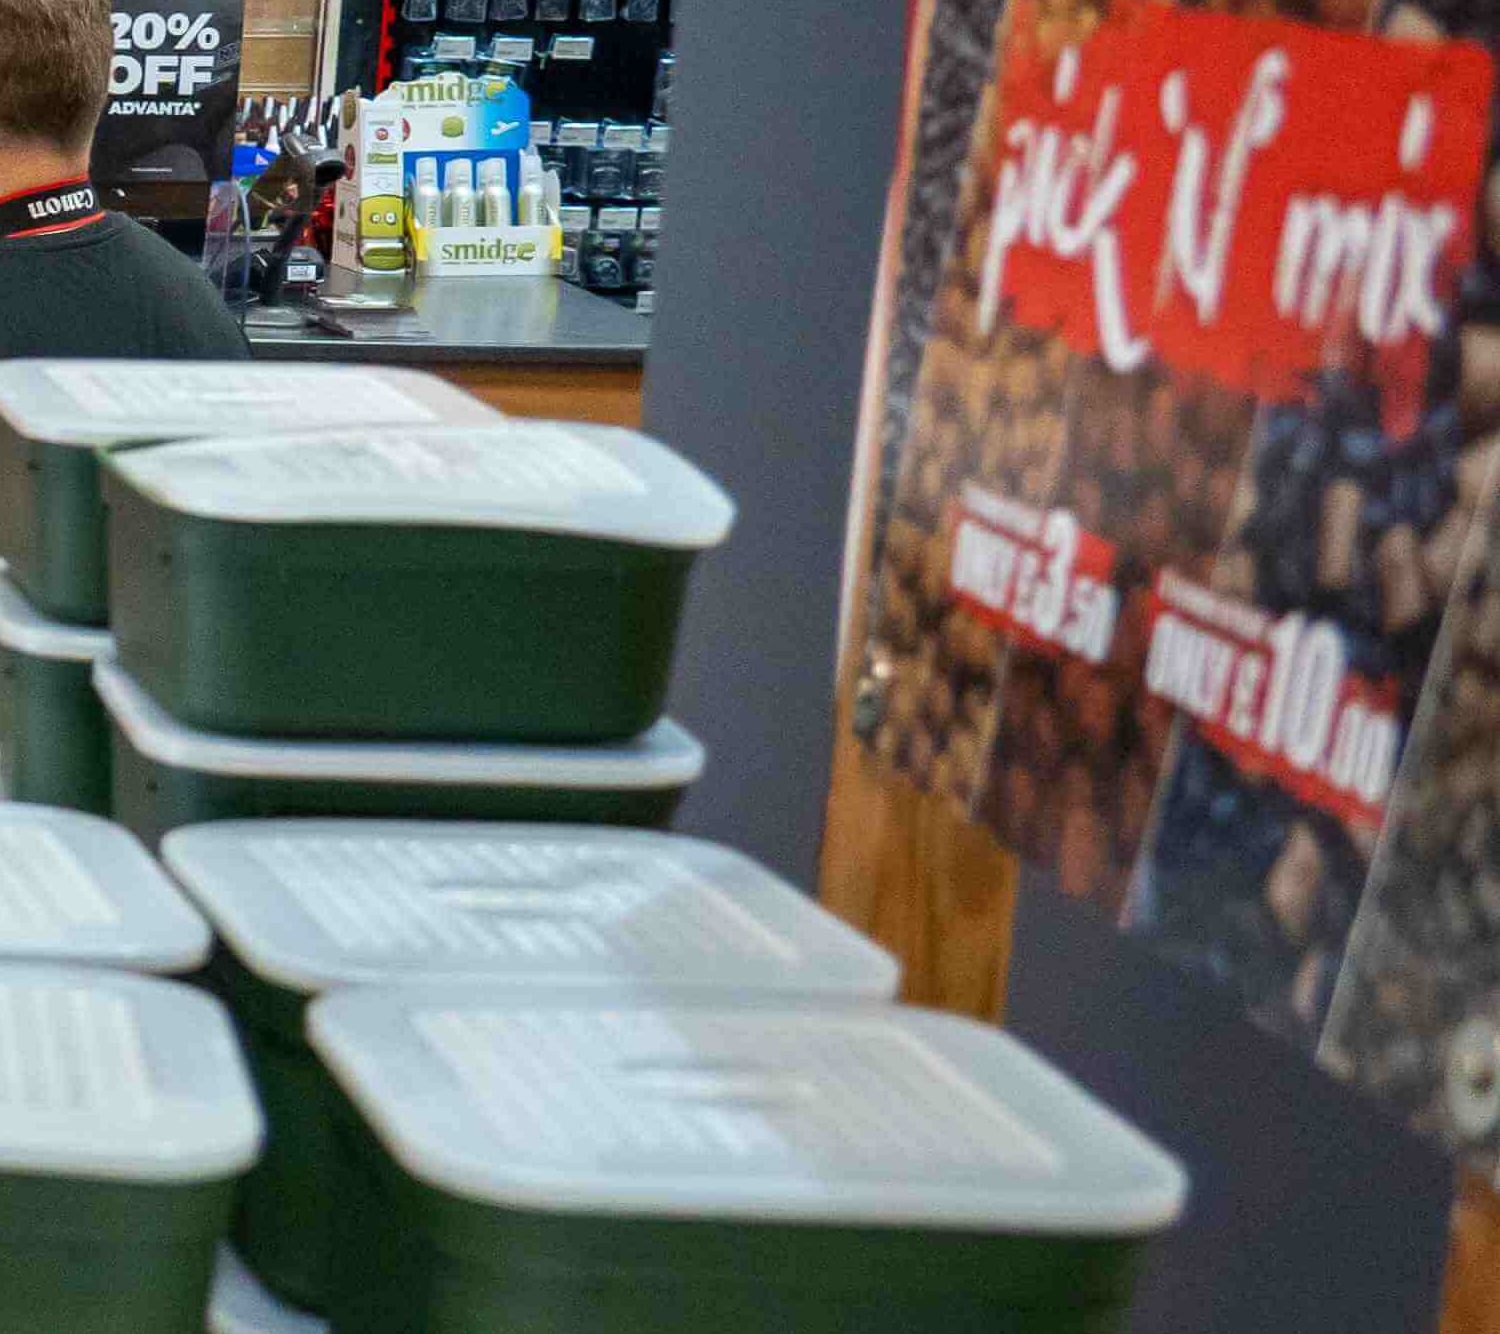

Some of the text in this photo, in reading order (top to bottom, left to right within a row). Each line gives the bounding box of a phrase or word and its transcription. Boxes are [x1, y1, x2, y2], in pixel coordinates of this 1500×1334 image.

[110, 12, 220, 50] 20%
[108, 55, 215, 95] OFF
[27, 188, 94, 219] Canon
[977, 42, 1152, 372] pick
[1274, 92, 1457, 345] mix
[442, 237, 536, 265] smidge
